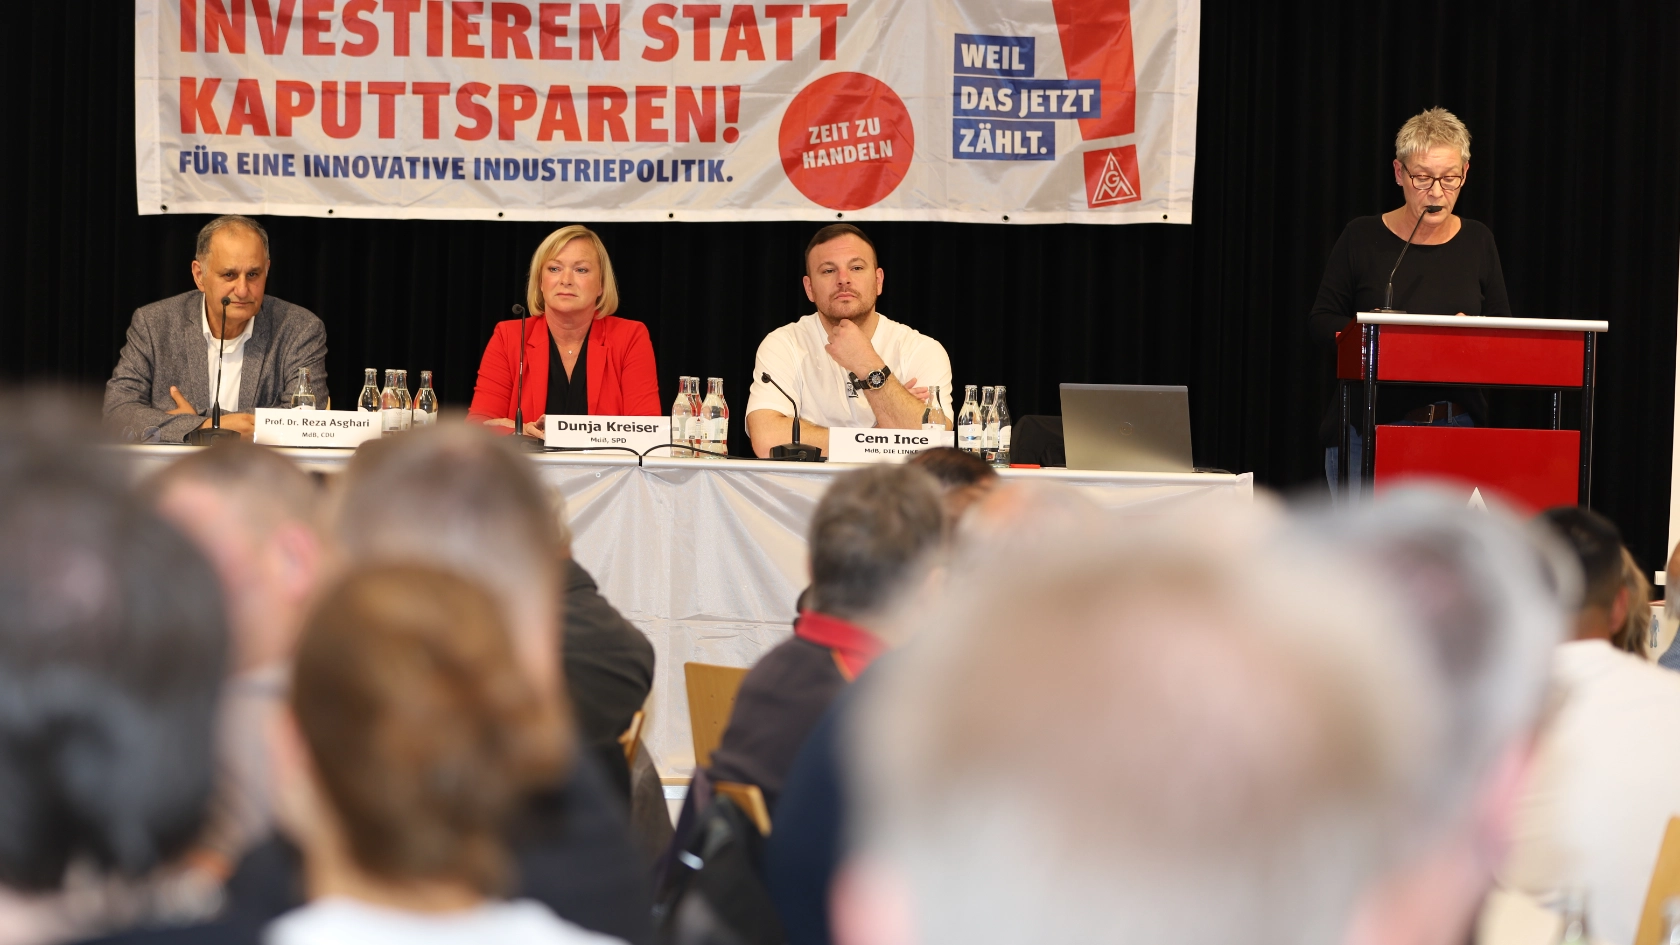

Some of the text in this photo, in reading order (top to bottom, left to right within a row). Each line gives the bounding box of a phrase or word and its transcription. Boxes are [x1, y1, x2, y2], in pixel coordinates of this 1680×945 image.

[179, 0, 848, 62] INVESTIEREN STATT
[961, 43, 1026, 71] WEIL
[179, 77, 741, 143] KAPUTTSPAREN!
[961, 85, 1095, 119] DAS JETZT
[808, 117, 881, 145] ZEIT ZU
[958, 122, 1048, 155] ZÄHLT.
[179, 145, 734, 184] FÜR EINE INNOVATIVE INDUSTRIEPOLITIK.
[802, 140, 893, 169] HANDELN
[264, 418, 370, 429] Prof. Dr. Reza Asghari
[557, 420, 659, 434] Dunja Kreiser
[854, 433, 929, 445] Cem Ince
